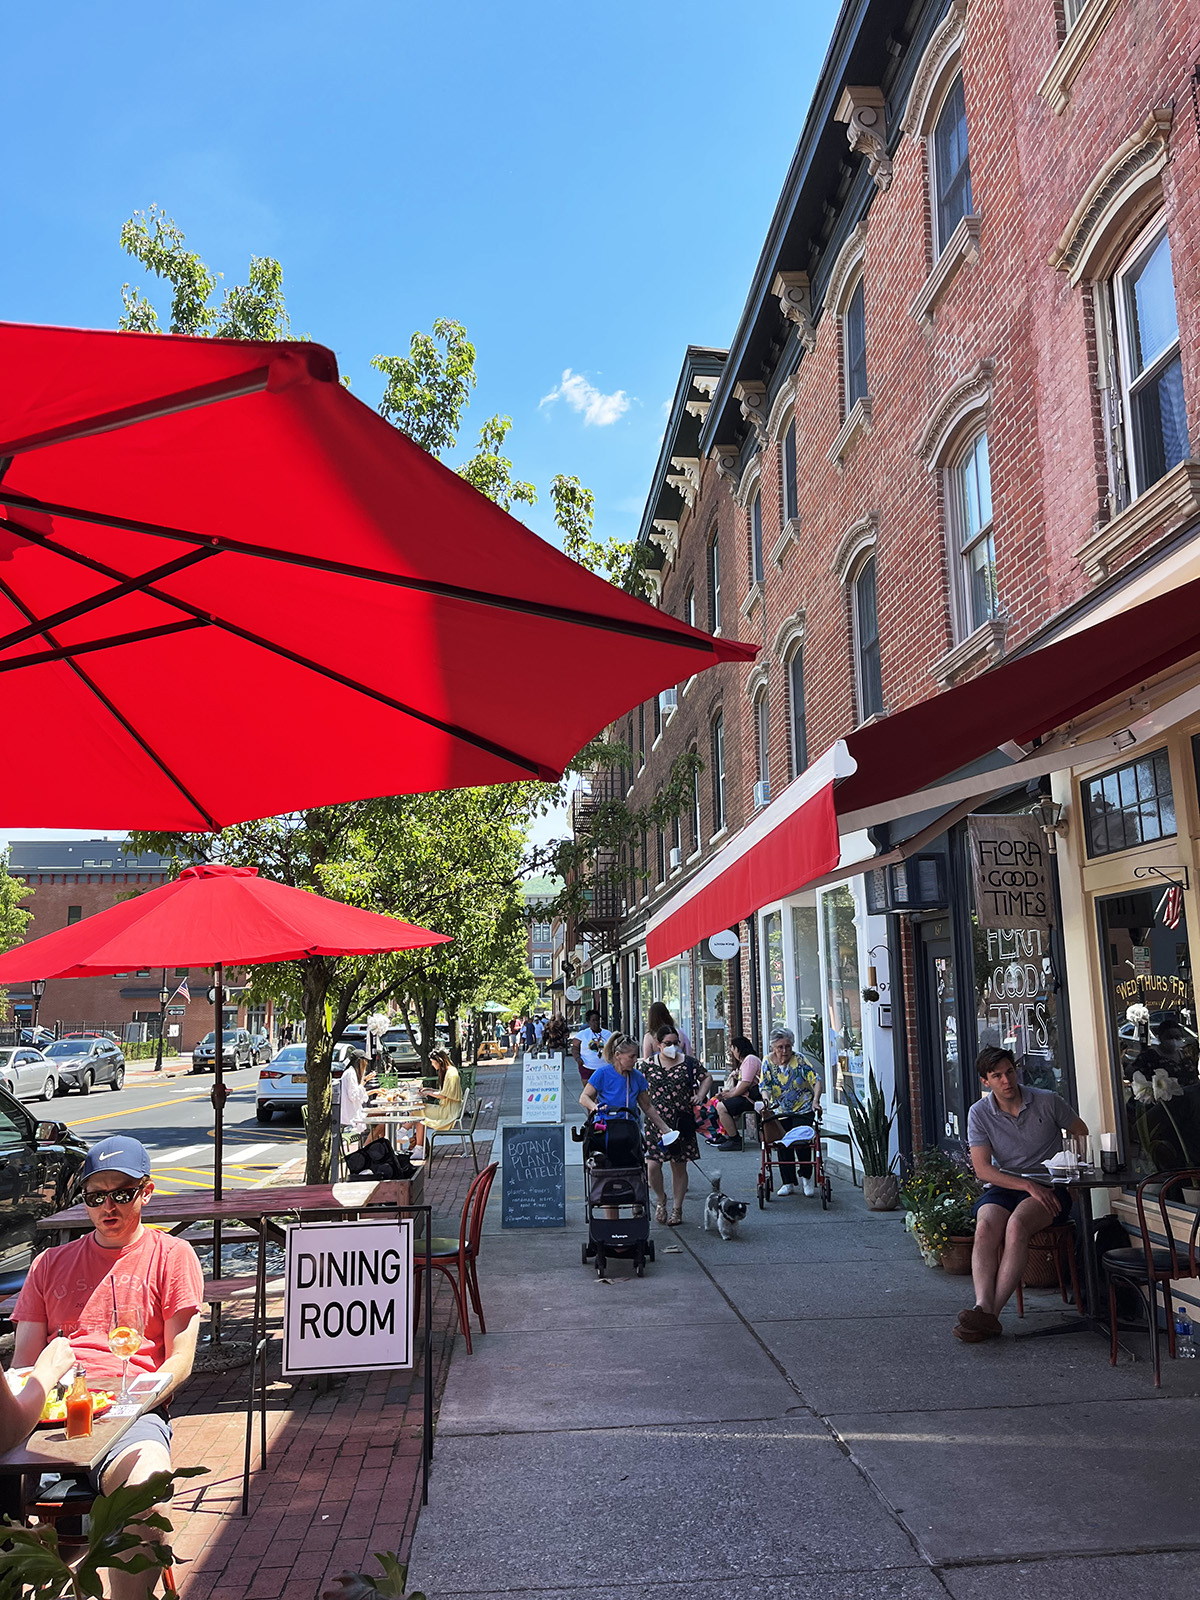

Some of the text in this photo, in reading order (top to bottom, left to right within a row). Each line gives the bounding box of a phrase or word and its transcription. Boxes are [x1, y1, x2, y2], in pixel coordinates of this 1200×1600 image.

[979, 840, 1042, 866] FLORA
[988, 870, 1039, 887] GOOD
[984, 890, 1046, 917] TIMES
[993, 963, 1039, 999] GOOD
[1136, 974, 1170, 992] THURS.
[989, 1002, 1049, 1056] TIMES
[508, 1138, 552, 1156] BOTANY
[511, 1150, 561, 1169] PLANTS
[516, 1162, 564, 1181] LATELY?
[297, 1248, 401, 1289] DINING
[53, 1278, 94, 1300] U.S.
[300, 1298, 395, 1340] ROOM
